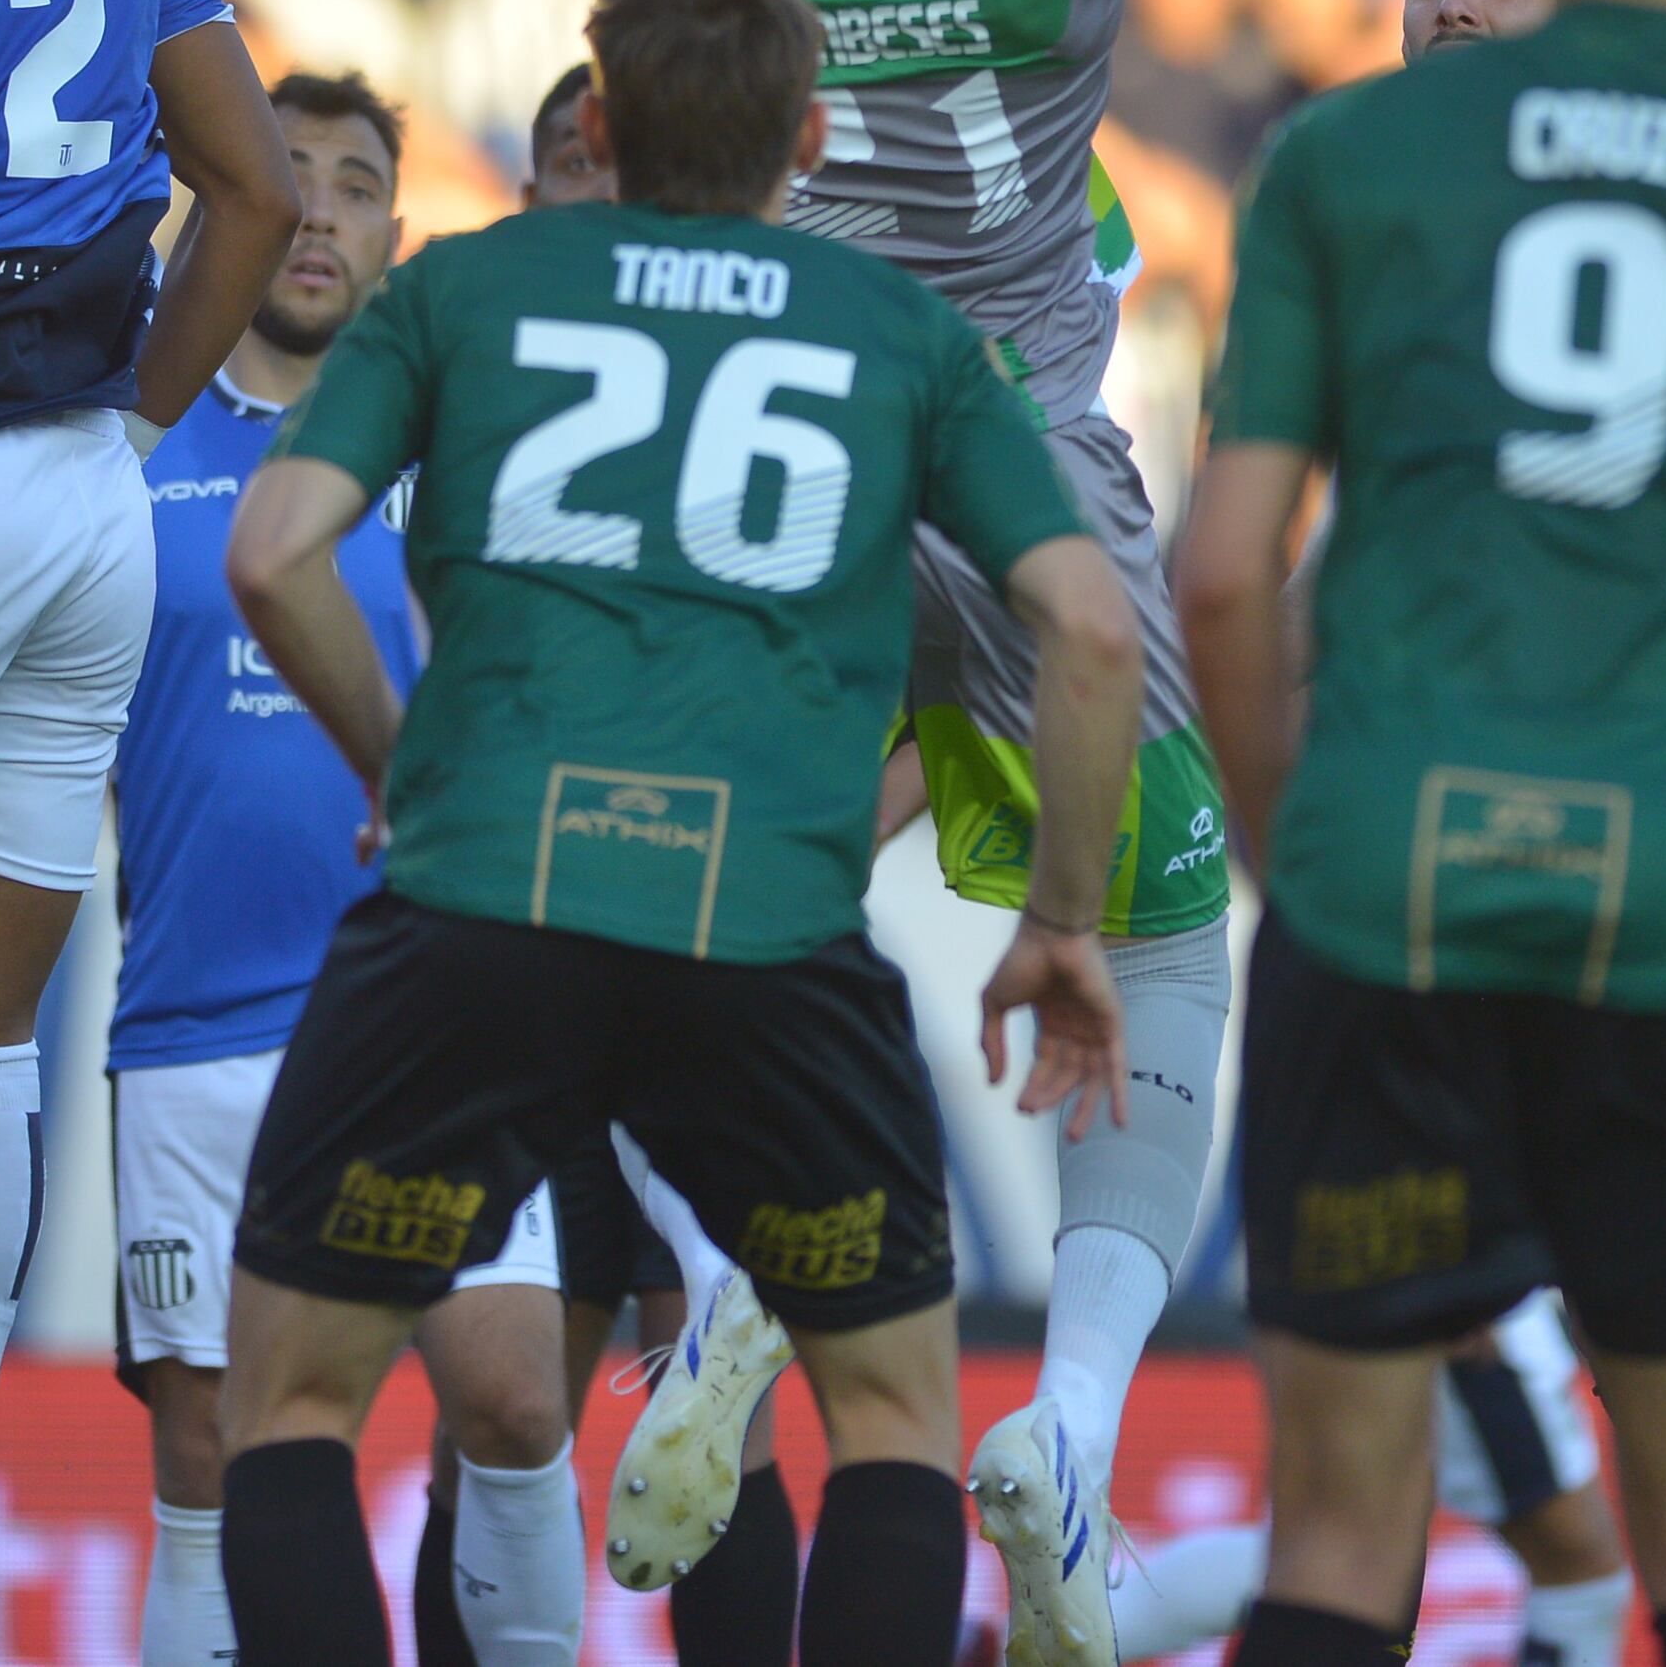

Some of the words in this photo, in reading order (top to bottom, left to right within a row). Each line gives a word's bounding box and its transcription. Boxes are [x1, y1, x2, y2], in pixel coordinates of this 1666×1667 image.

[613, 244, 789, 319] TANCO
[483, 316, 858, 594] 26
[228, 635, 276, 678] IC
[227, 688, 309, 718] Argen
